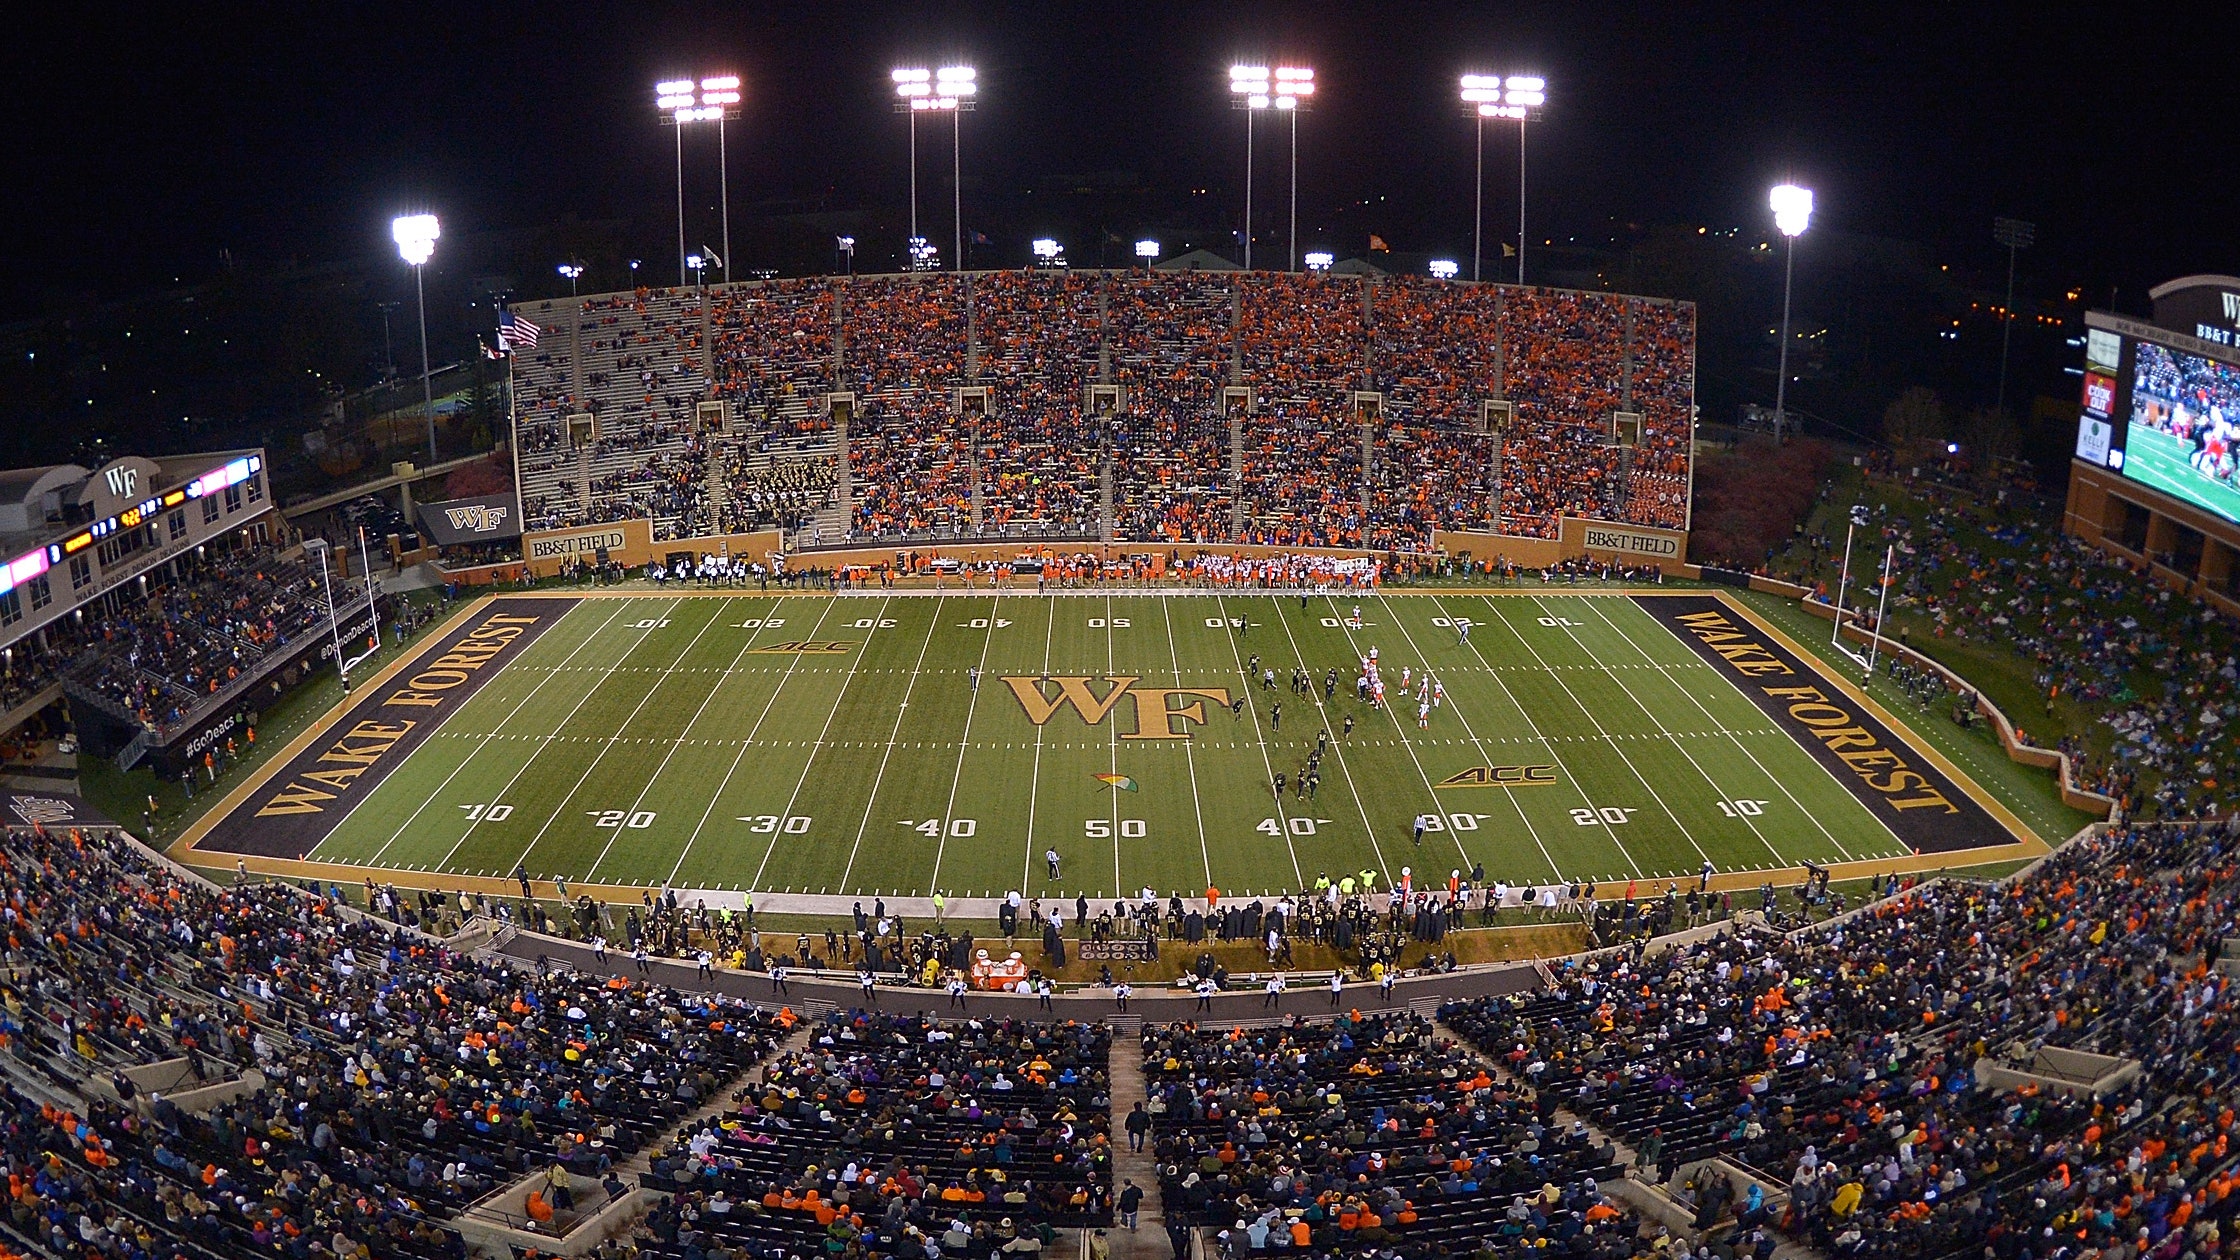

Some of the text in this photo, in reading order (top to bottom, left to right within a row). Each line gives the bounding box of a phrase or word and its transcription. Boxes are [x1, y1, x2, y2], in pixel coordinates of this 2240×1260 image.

[2196, 323, 2231, 345] BB&T
[105, 465, 137, 499] WF
[445, 504, 507, 532] WF
[533, 533, 624, 557] BB&T FIELD
[1587, 531, 1676, 555] BB&T FIELD
[635, 619, 671, 629] 10
[742, 618, 786, 629] 20
[854, 618, 898, 628] 30
[970, 618, 1013, 629] 40
[1088, 618, 1131, 628] 50
[1537, 617, 1573, 626] 10
[321, 612, 382, 660] @DemonDeacos
[254, 613, 540, 817] WAKE FOREST
[997, 675, 1233, 739] WF
[1674, 611, 1959, 813] WAKE FOREST
[186, 715, 235, 759] #GoDeacs
[1443, 765, 1558, 783] ACC
[465, 804, 514, 821] 10
[1569, 807, 1628, 826] 20
[1716, 800, 1763, 817] 10
[596, 811, 657, 828] 20
[750, 816, 811, 834] 30
[915, 819, 976, 837] 40
[1255, 818, 1316, 836] 40
[1424, 813, 1479, 832] 30
[1085, 820, 1146, 838] 50
